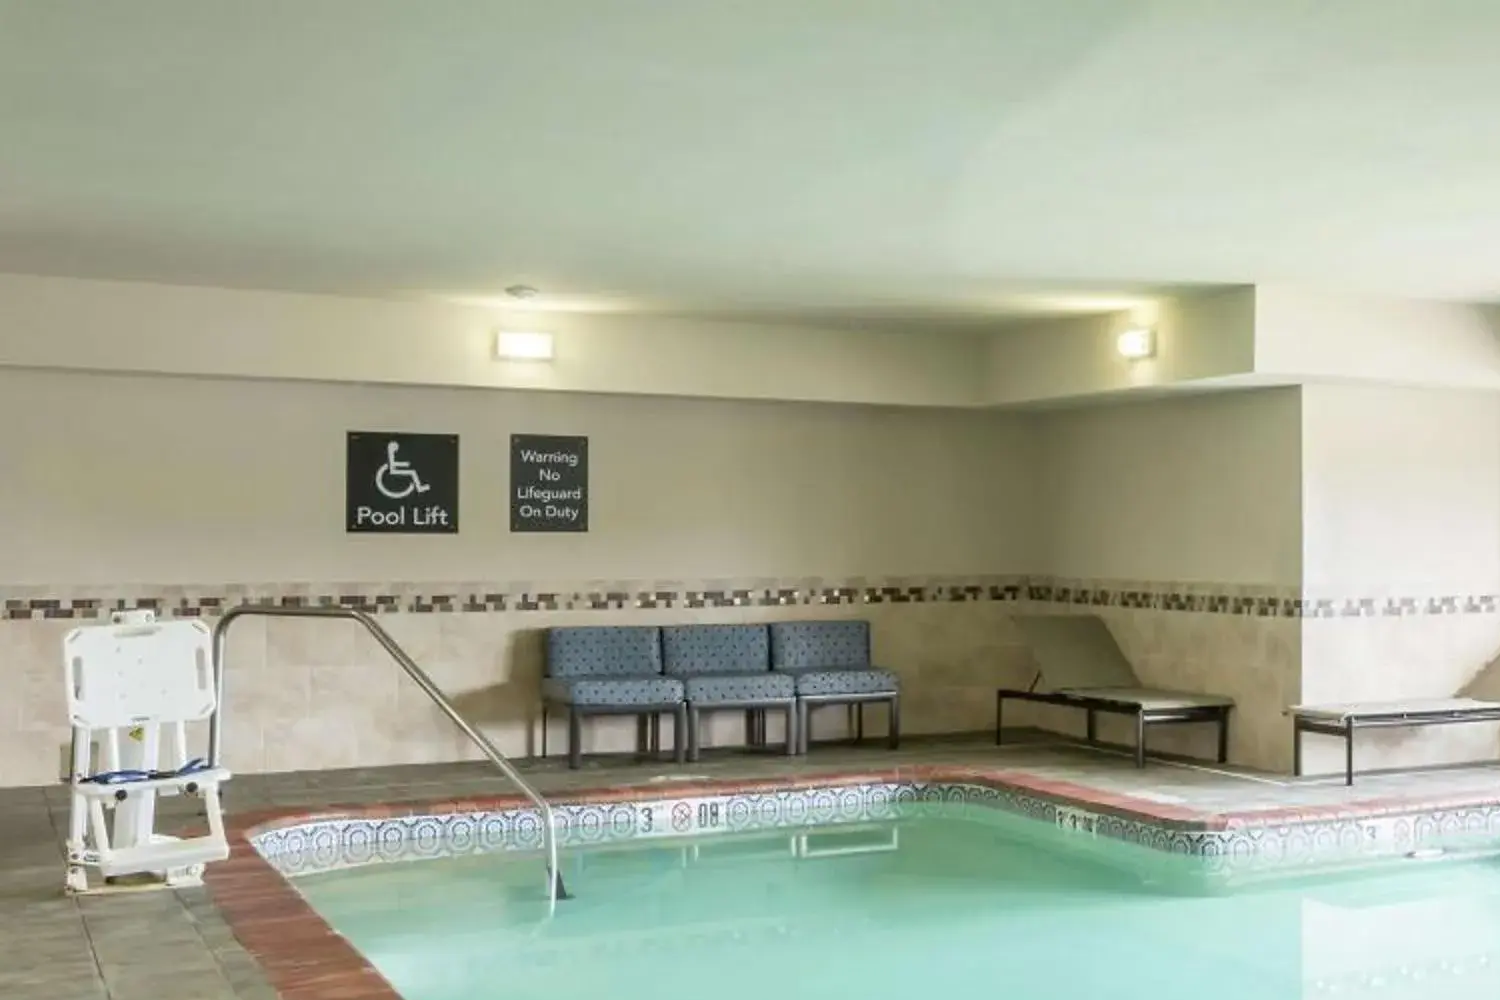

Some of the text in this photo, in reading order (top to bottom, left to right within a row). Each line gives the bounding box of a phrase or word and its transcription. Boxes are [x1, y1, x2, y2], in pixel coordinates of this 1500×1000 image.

[520, 449, 579, 467] Warning
[539, 468, 561, 482] No
[517, 485, 582, 502] Lifeguard
[357, 505, 449, 526] Pool Lift
[519, 504, 579, 520] On Duty
